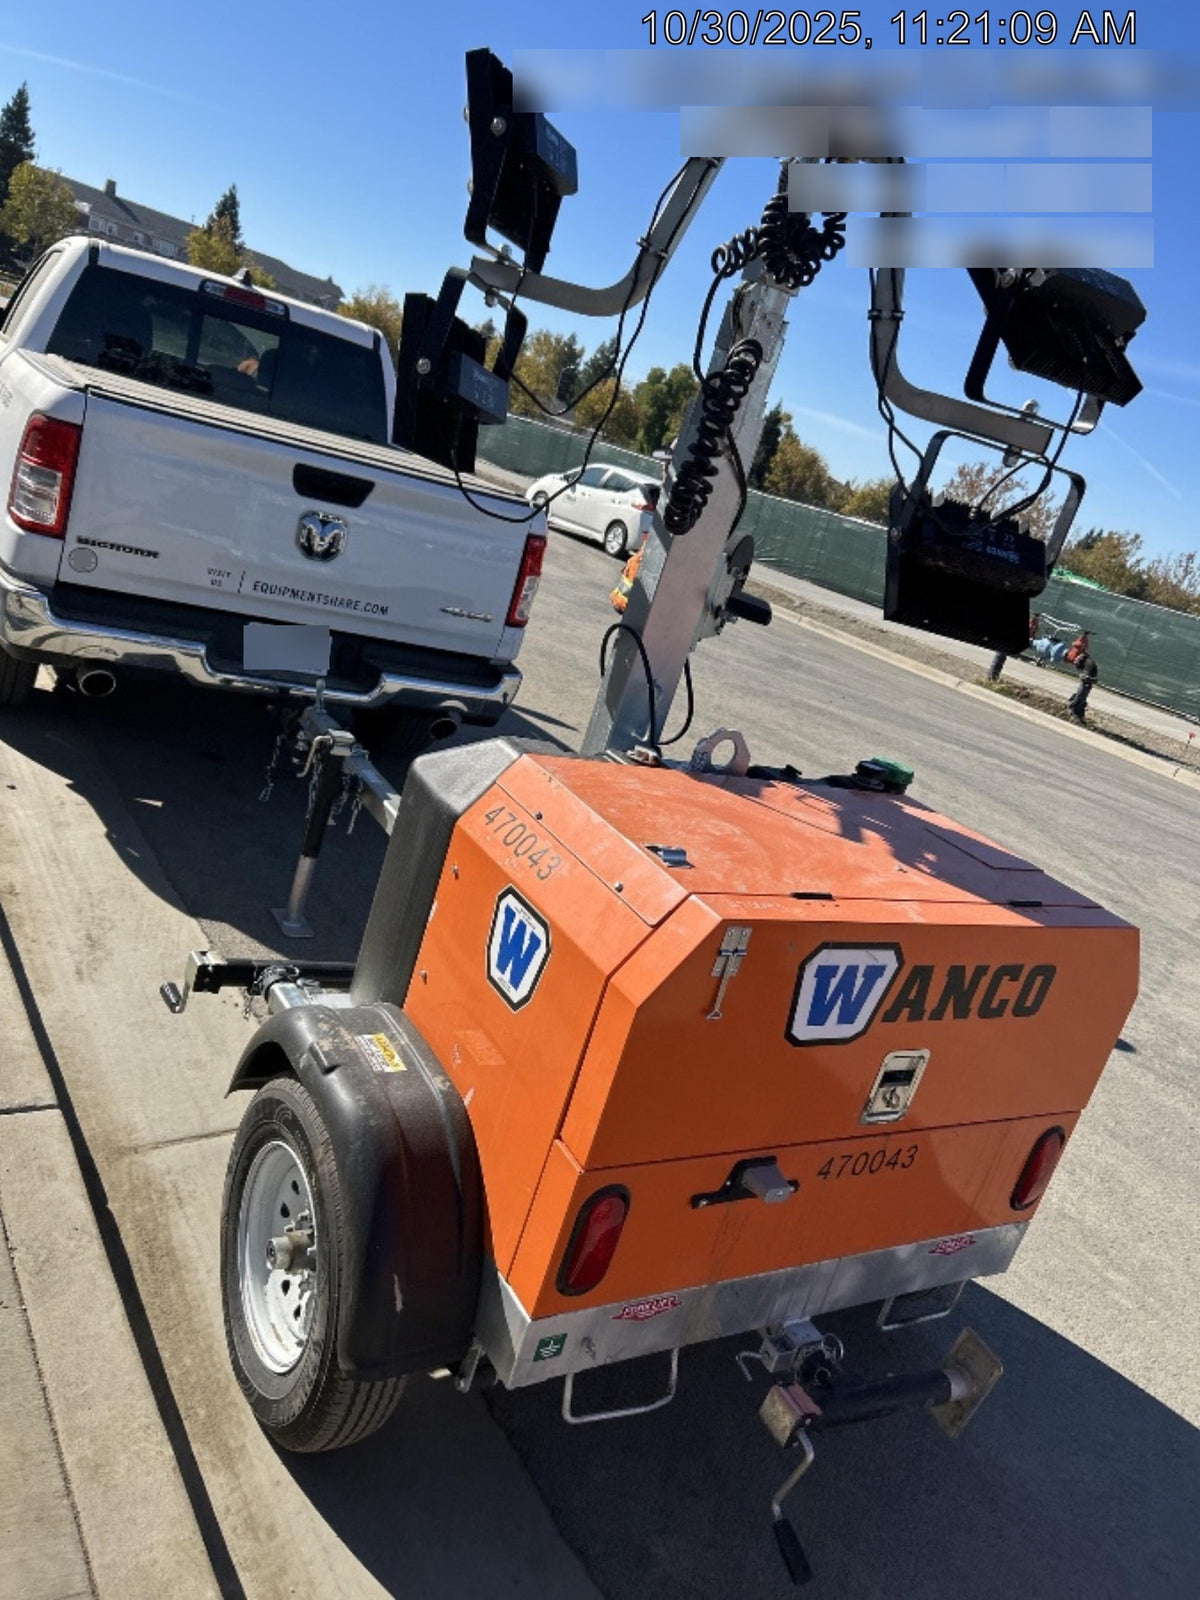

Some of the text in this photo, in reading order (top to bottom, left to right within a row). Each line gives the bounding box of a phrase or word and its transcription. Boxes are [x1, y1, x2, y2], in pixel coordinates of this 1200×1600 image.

[252, 580, 390, 617] EQUIPMENTSHARE.COM
[484, 805, 562, 881] 470043
[496, 903, 543, 992] W
[806, 963, 1057, 1027] WANCO
[817, 1144, 919, 1181] 470043
